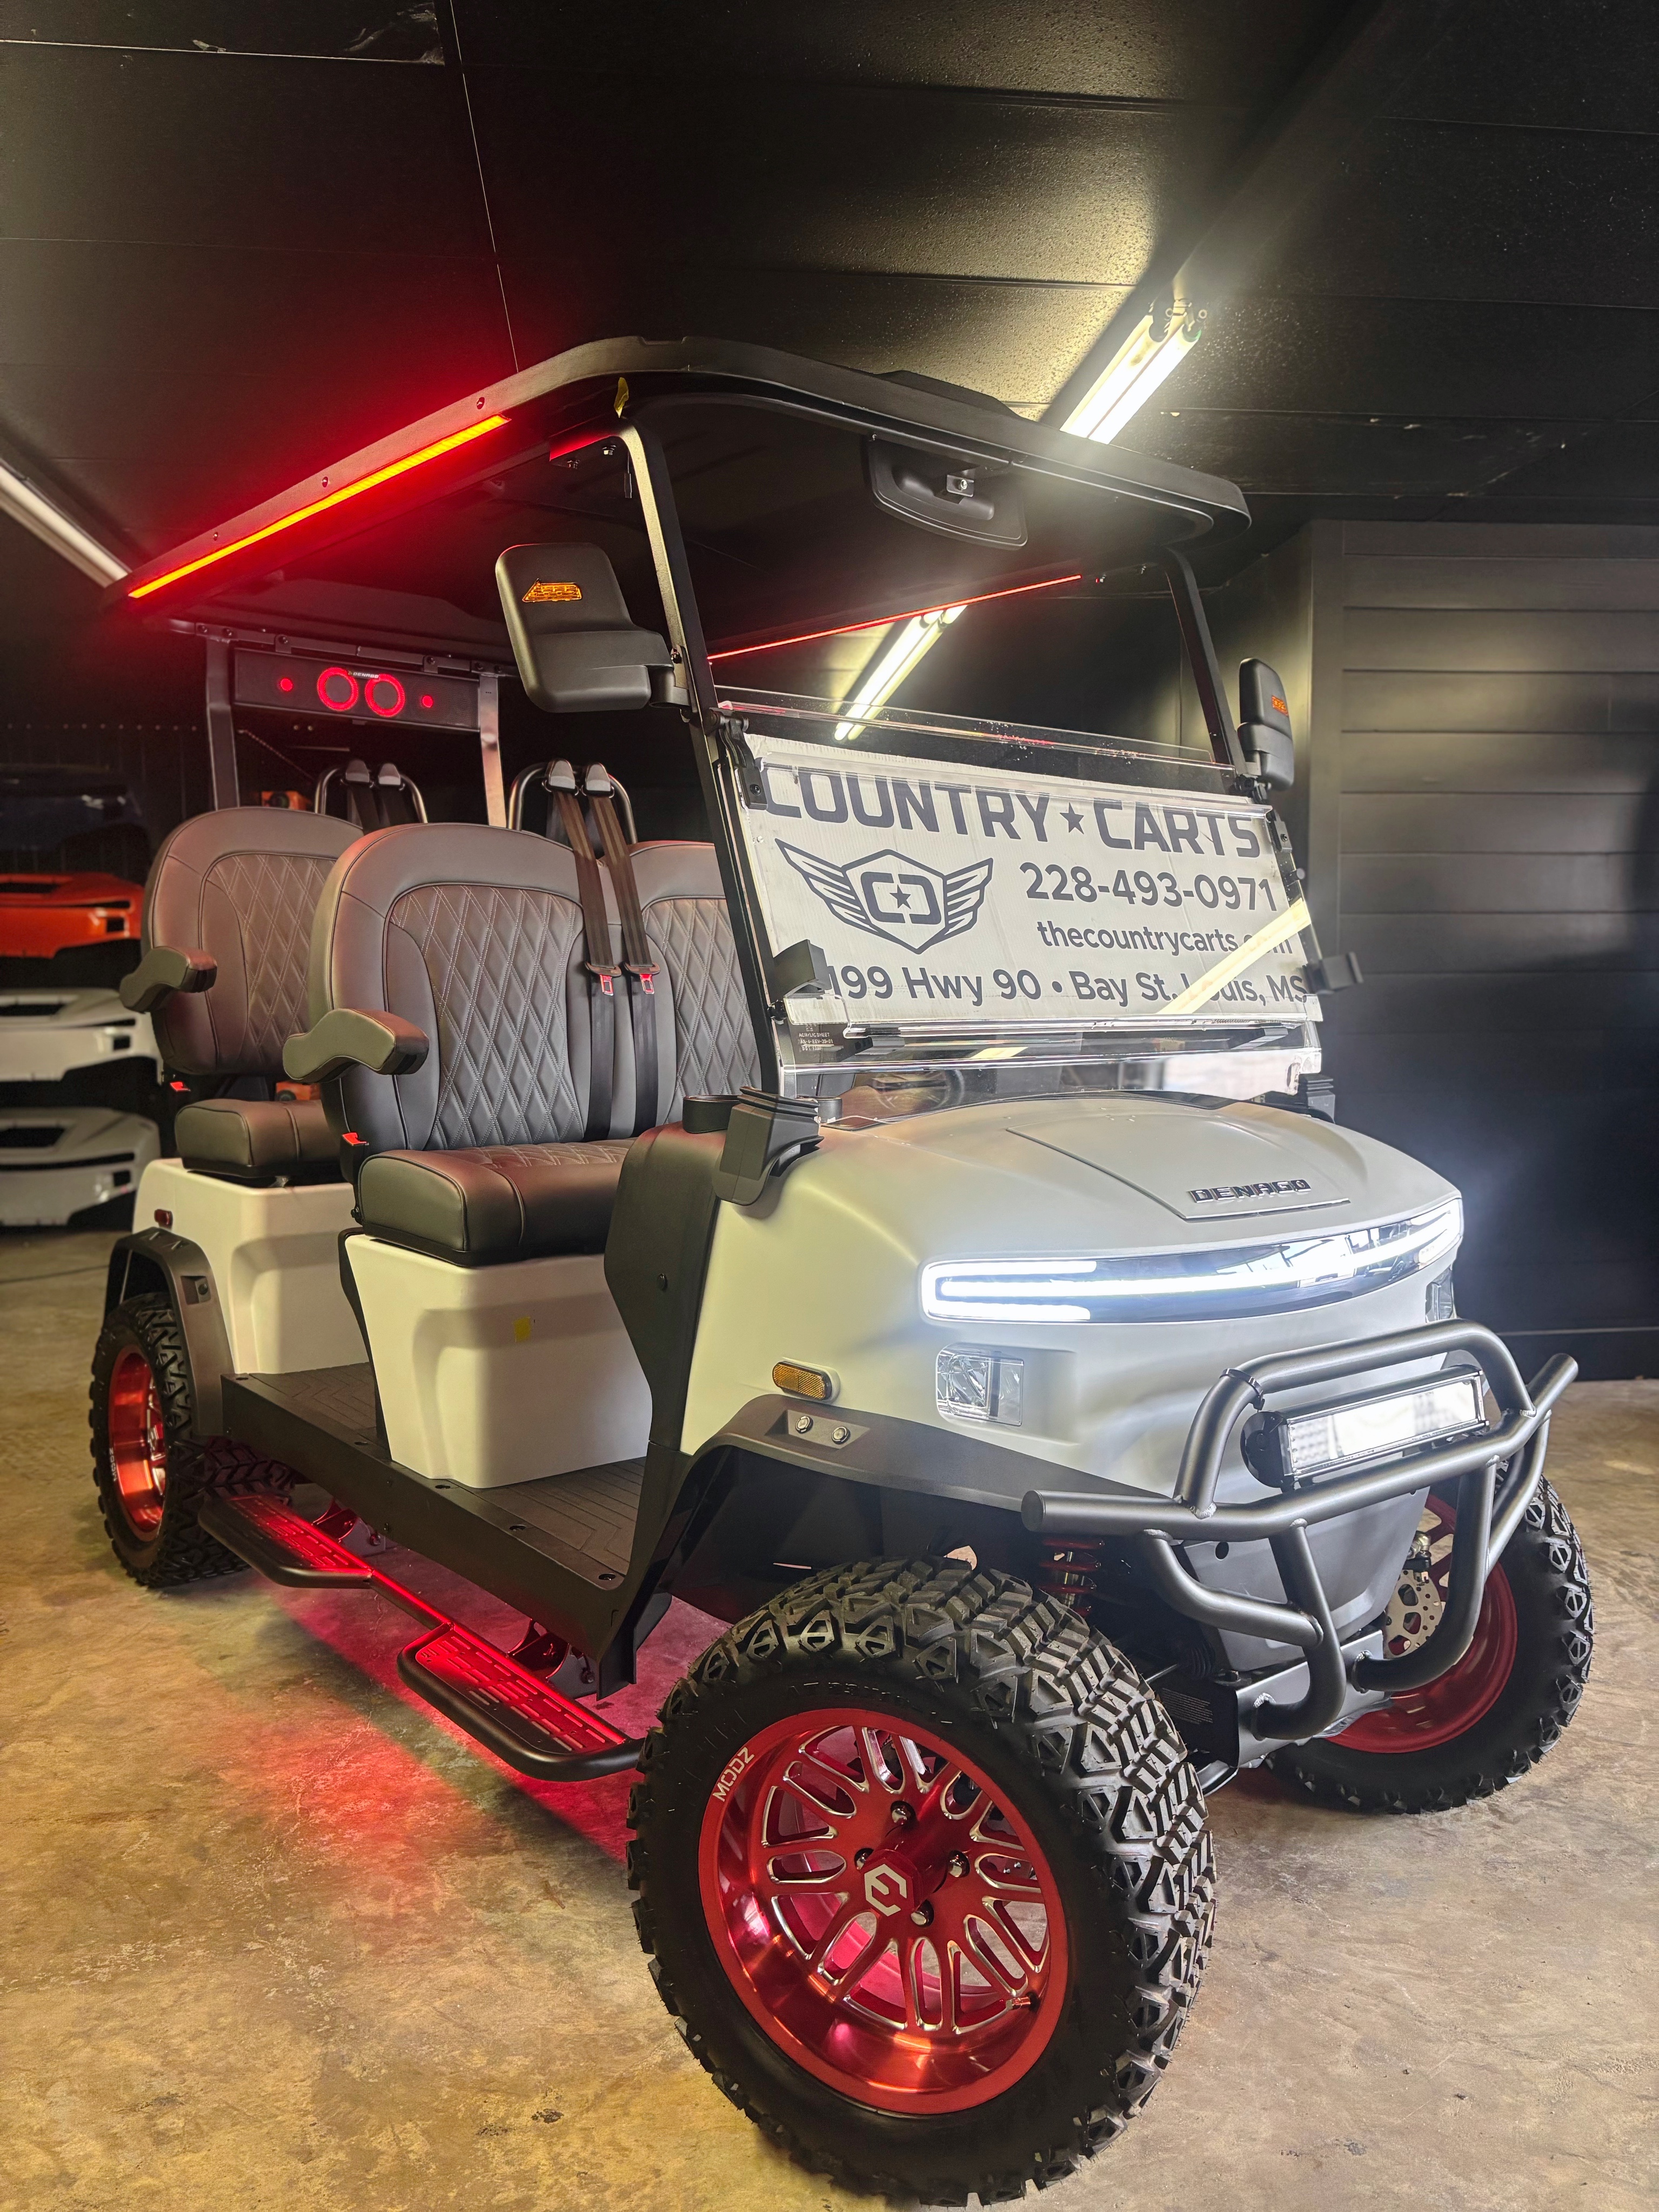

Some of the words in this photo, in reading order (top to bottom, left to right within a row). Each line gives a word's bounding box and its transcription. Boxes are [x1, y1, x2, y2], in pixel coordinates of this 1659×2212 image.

[754, 757, 1050, 842] COUNTRY
[1092, 799, 1261, 858] CARTS
[1019, 862, 1277, 911] 228-493-0971
[1037, 920, 1293, 956] thecountrycartsm
[901, 967, 982, 1006] Hwy
[992, 969, 1041, 1000] 90
[1068, 970, 1127, 1007] Bay
[1136, 972, 1178, 1001] St.
[1266, 975, 1307, 1003] MS
[1188, 1179, 1312, 1203] DENAGO
[712, 1747, 755, 1802] MODZ
